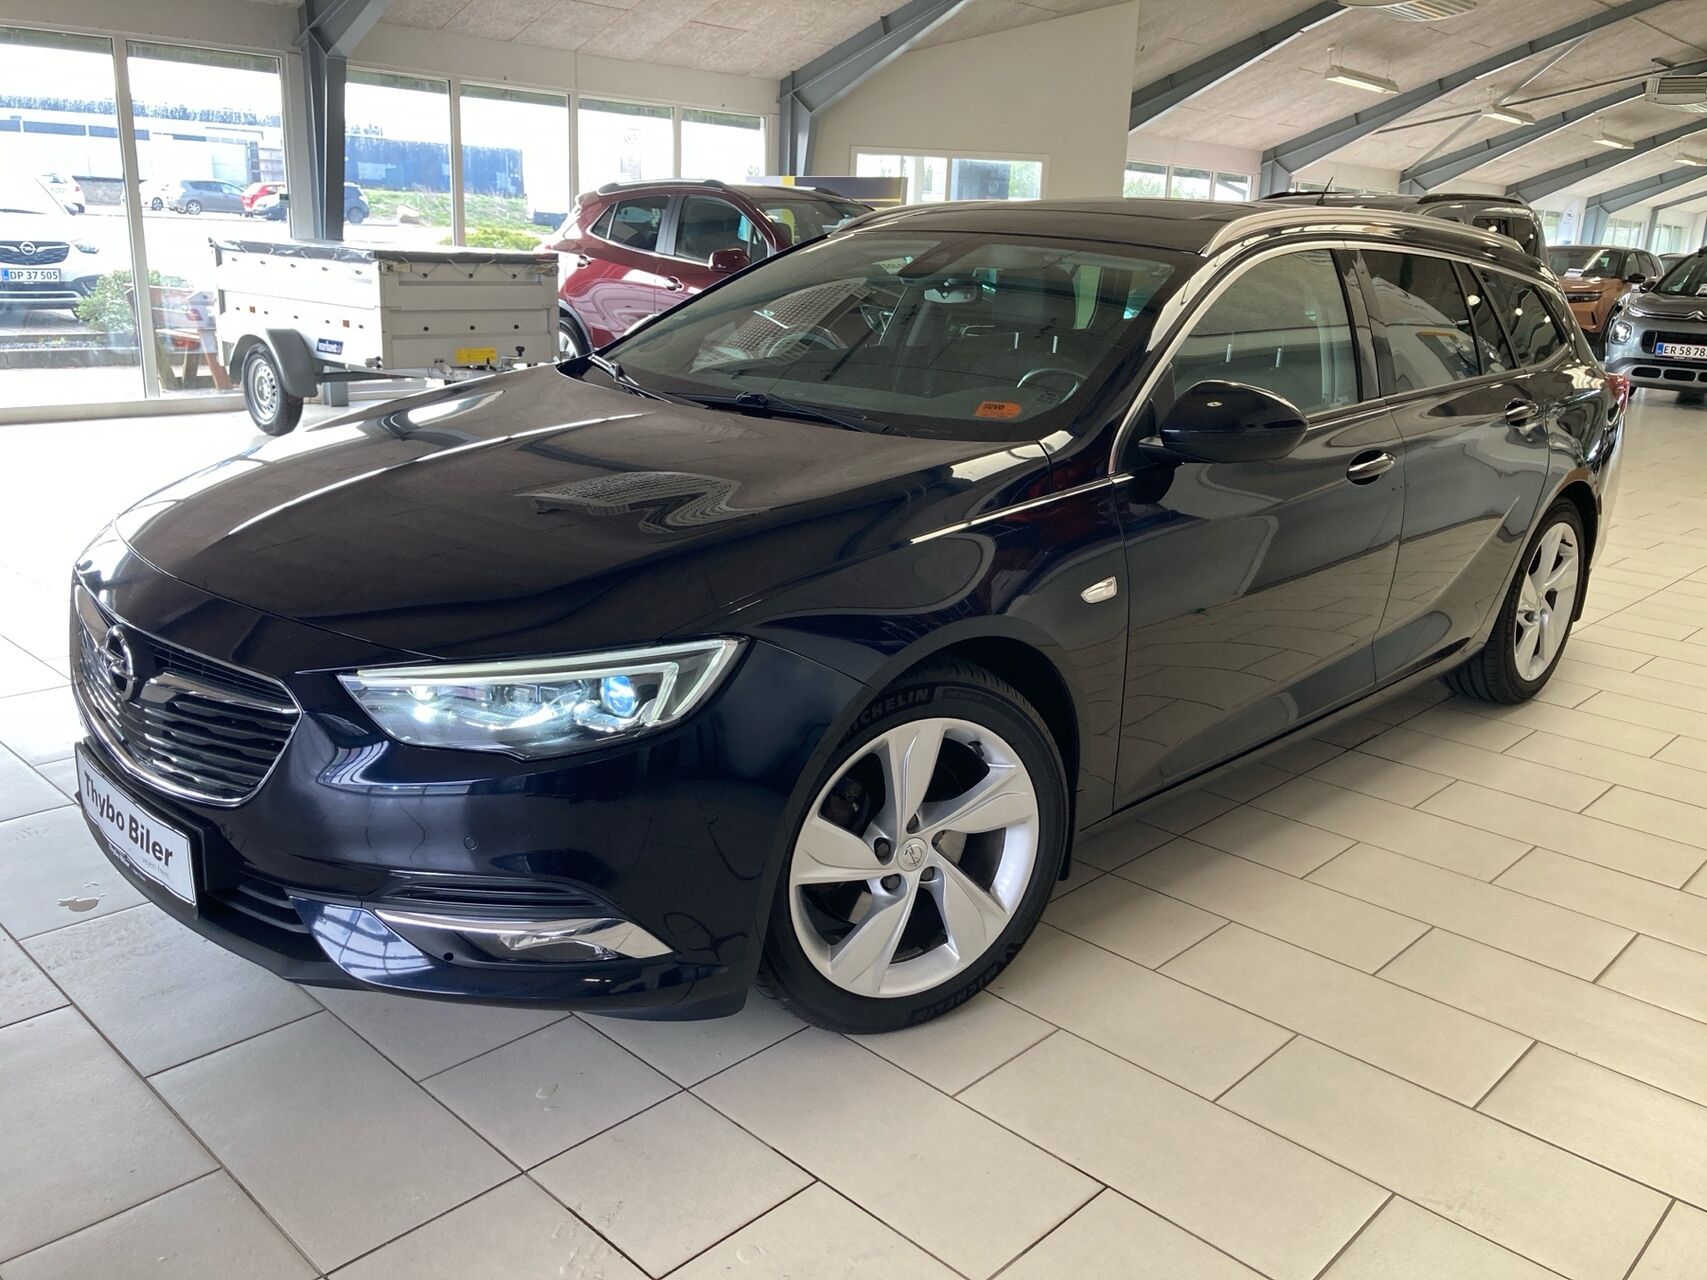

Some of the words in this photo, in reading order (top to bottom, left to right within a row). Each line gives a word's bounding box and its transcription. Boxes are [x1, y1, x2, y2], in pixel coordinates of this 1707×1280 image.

[10, 271, 23, 280] DP
[26, 271, 38, 280] 37
[40, 271, 58, 280] 505
[1663, 346, 1677, 354] ER
[1679, 346, 1692, 356] 58
[1693, 347, 1707, 357] 78
[845, 688, 929, 737] ICHELIN
[84, 770, 125, 831] Thybo
[129, 814, 173, 867] Biler
